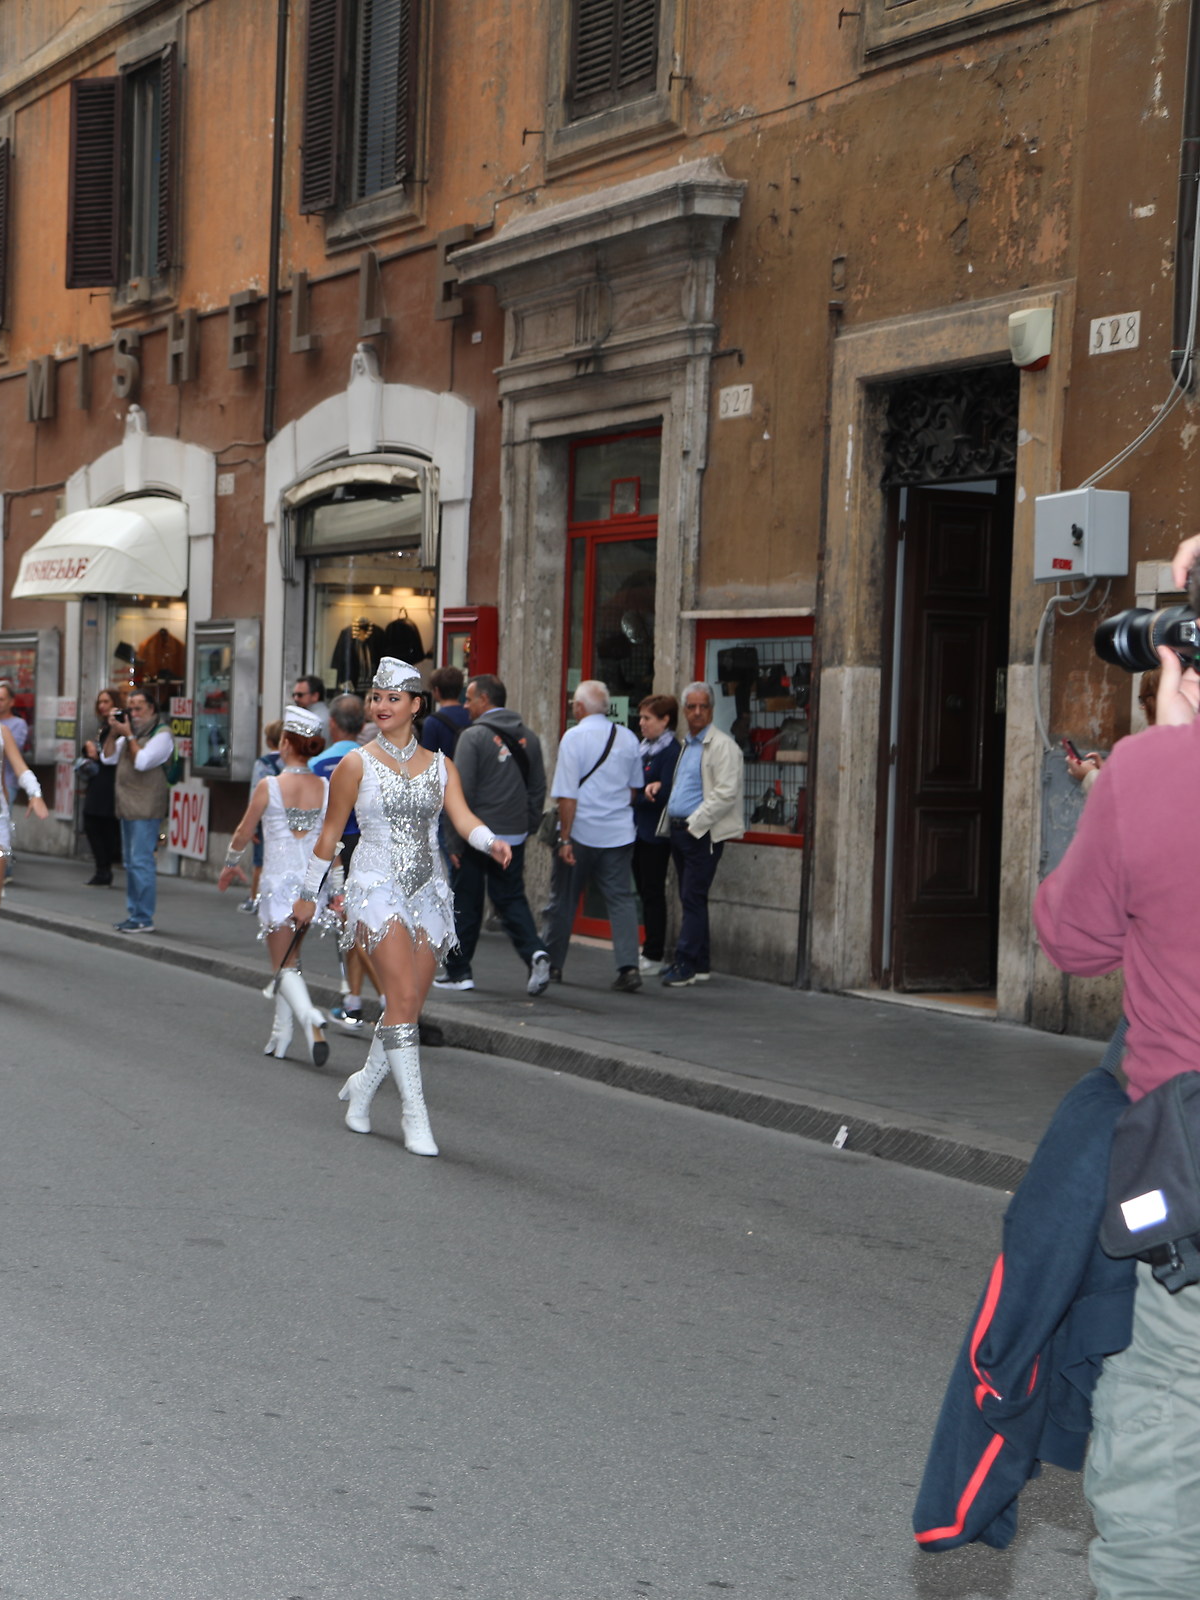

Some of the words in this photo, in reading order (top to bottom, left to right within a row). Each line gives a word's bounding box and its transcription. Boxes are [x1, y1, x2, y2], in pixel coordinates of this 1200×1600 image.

[1093, 315, 1136, 349] 528
[721, 388, 750, 414] 527
[171, 792, 205, 854] 50%
